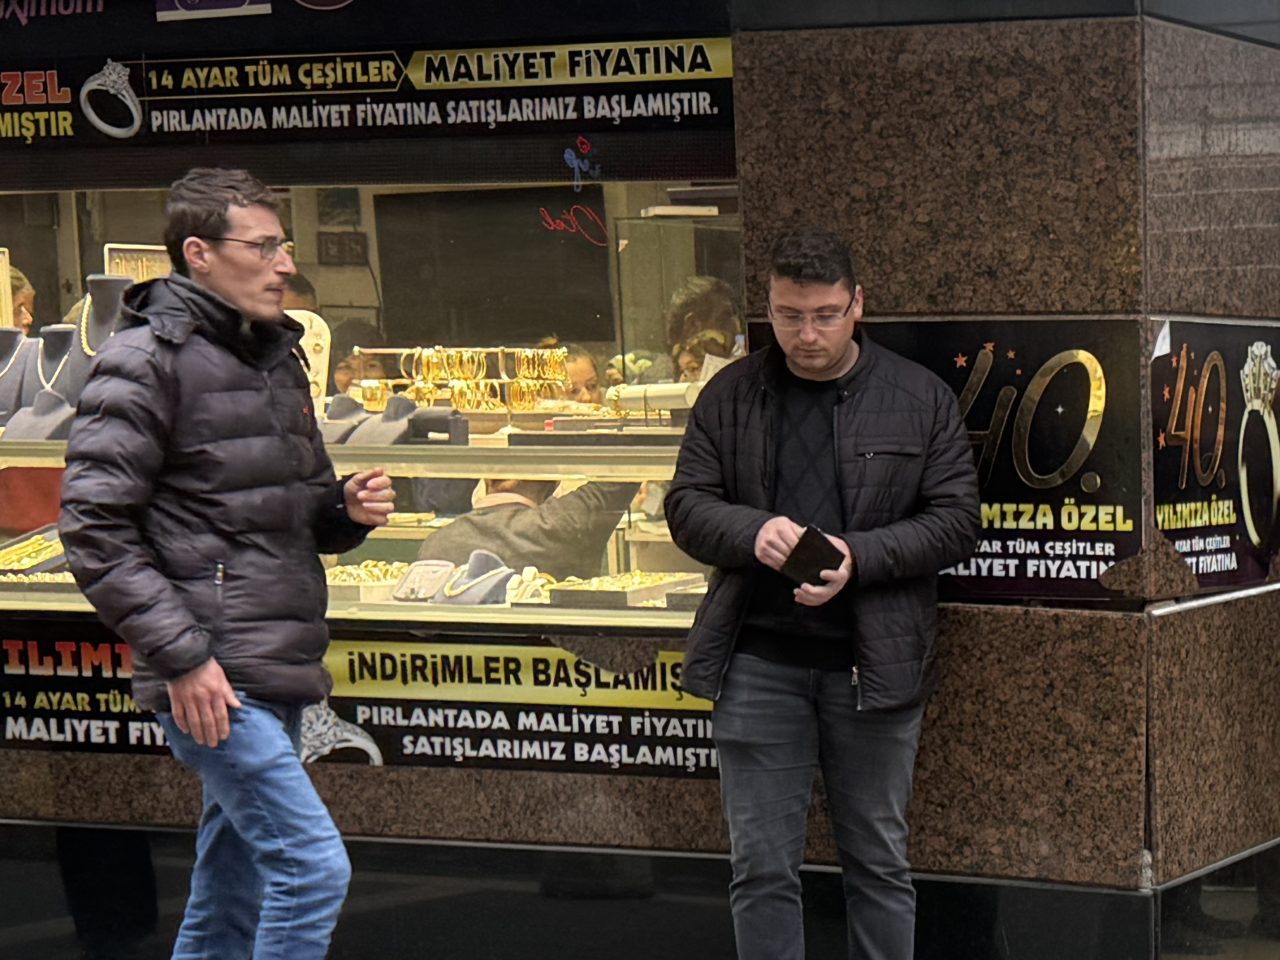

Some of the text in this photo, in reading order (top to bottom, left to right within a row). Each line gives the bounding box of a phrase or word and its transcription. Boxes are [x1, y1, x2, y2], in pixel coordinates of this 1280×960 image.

[148, 57, 398, 90] 14 AYAR TÜM ÇEŞİTLER
[424, 44, 713, 84] MALİYET FİYATINA
[151, 91, 719, 132] PIRLANTADA MALİYET FİYATINA SATIŞLARIMIZ BAŞLAMIŞTIR.
[1061, 497, 1133, 532] ÖZEL
[1156, 494, 1237, 531] YILIMIZA ÖZEL
[975, 539, 1115, 559] AR TÜM ÇEŞİTLER
[347, 651, 522, 688] İNDİRİMLER
[2, 691, 27, 709] 14
[34, 691, 90, 712] AYAR
[128, 721, 169, 746] FİY
[356, 705, 511, 731] PIRLANTADA
[517, 707, 622, 735] MALİYET
[402, 735, 566, 763] SATIŞLARIMIZ
